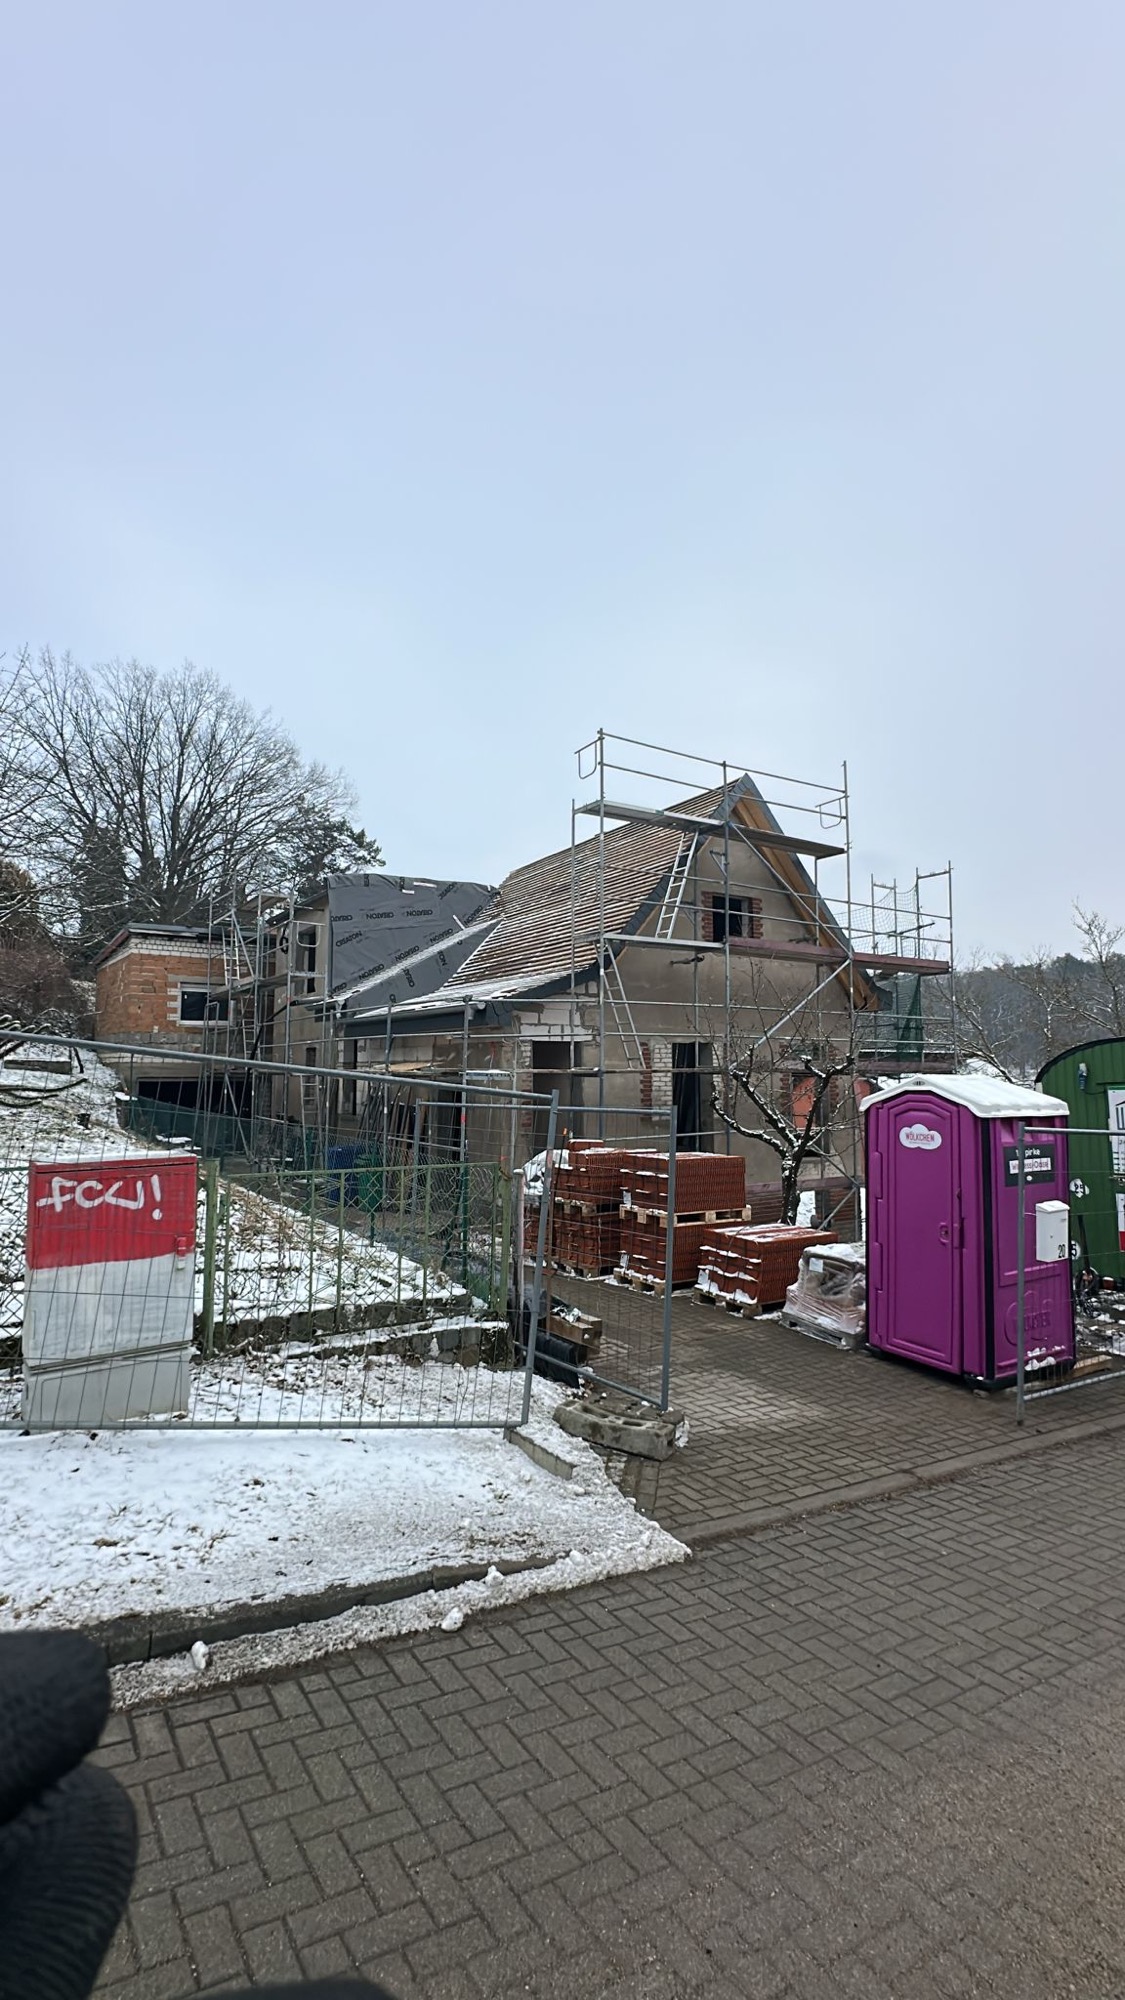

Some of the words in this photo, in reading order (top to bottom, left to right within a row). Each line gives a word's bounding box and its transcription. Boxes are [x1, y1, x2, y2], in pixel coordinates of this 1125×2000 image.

[366, 911, 394, 920] CREATON
[406, 909, 433, 917] CREATON
[335, 930, 363, 947] CREATON
